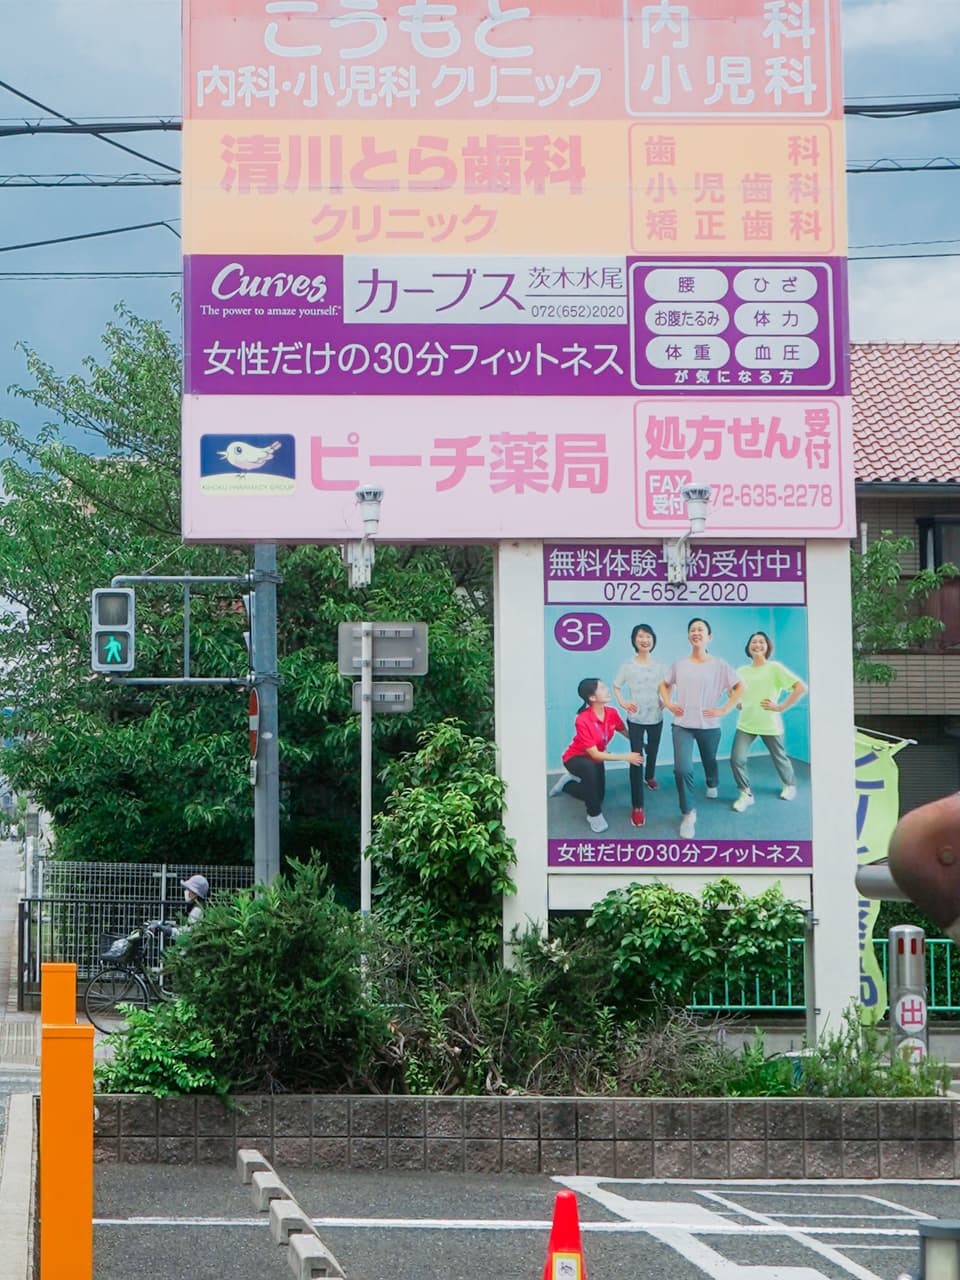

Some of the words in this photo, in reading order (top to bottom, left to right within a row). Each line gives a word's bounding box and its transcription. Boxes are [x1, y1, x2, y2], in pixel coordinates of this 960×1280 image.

[432, 65, 602, 107] クリニック
[220, 134, 586, 195] 清川とら歯科
[312, 204, 498, 244] クリニック
[211, 262, 327, 303] Curves
[356, 268, 526, 314] カーブス
[528, 266, 624, 291] 茨木水尾
[678, 276, 695, 293] 腰
[200, 305, 220, 316] The
[222, 307, 252, 318] power
[254, 307, 265, 316] to
[267, 308, 297, 316] amaze
[531, 304, 624, 320] 072(652)2020
[654, 310, 720, 327] お腹たるみ
[203, 342, 625, 377] 女性だけの30分フィットネス
[645, 415, 801, 461] 処方せん
[310, 431, 608, 495] ピーチ薬局
[650, 475, 687, 493] FAX
[708, 484, 833, 507] 72-635-2278
[603, 582, 749, 602] 072-652-2020
[561, 618, 603, 646] 3F
[557, 843, 804, 864] 女性だけの30分フィットネス
